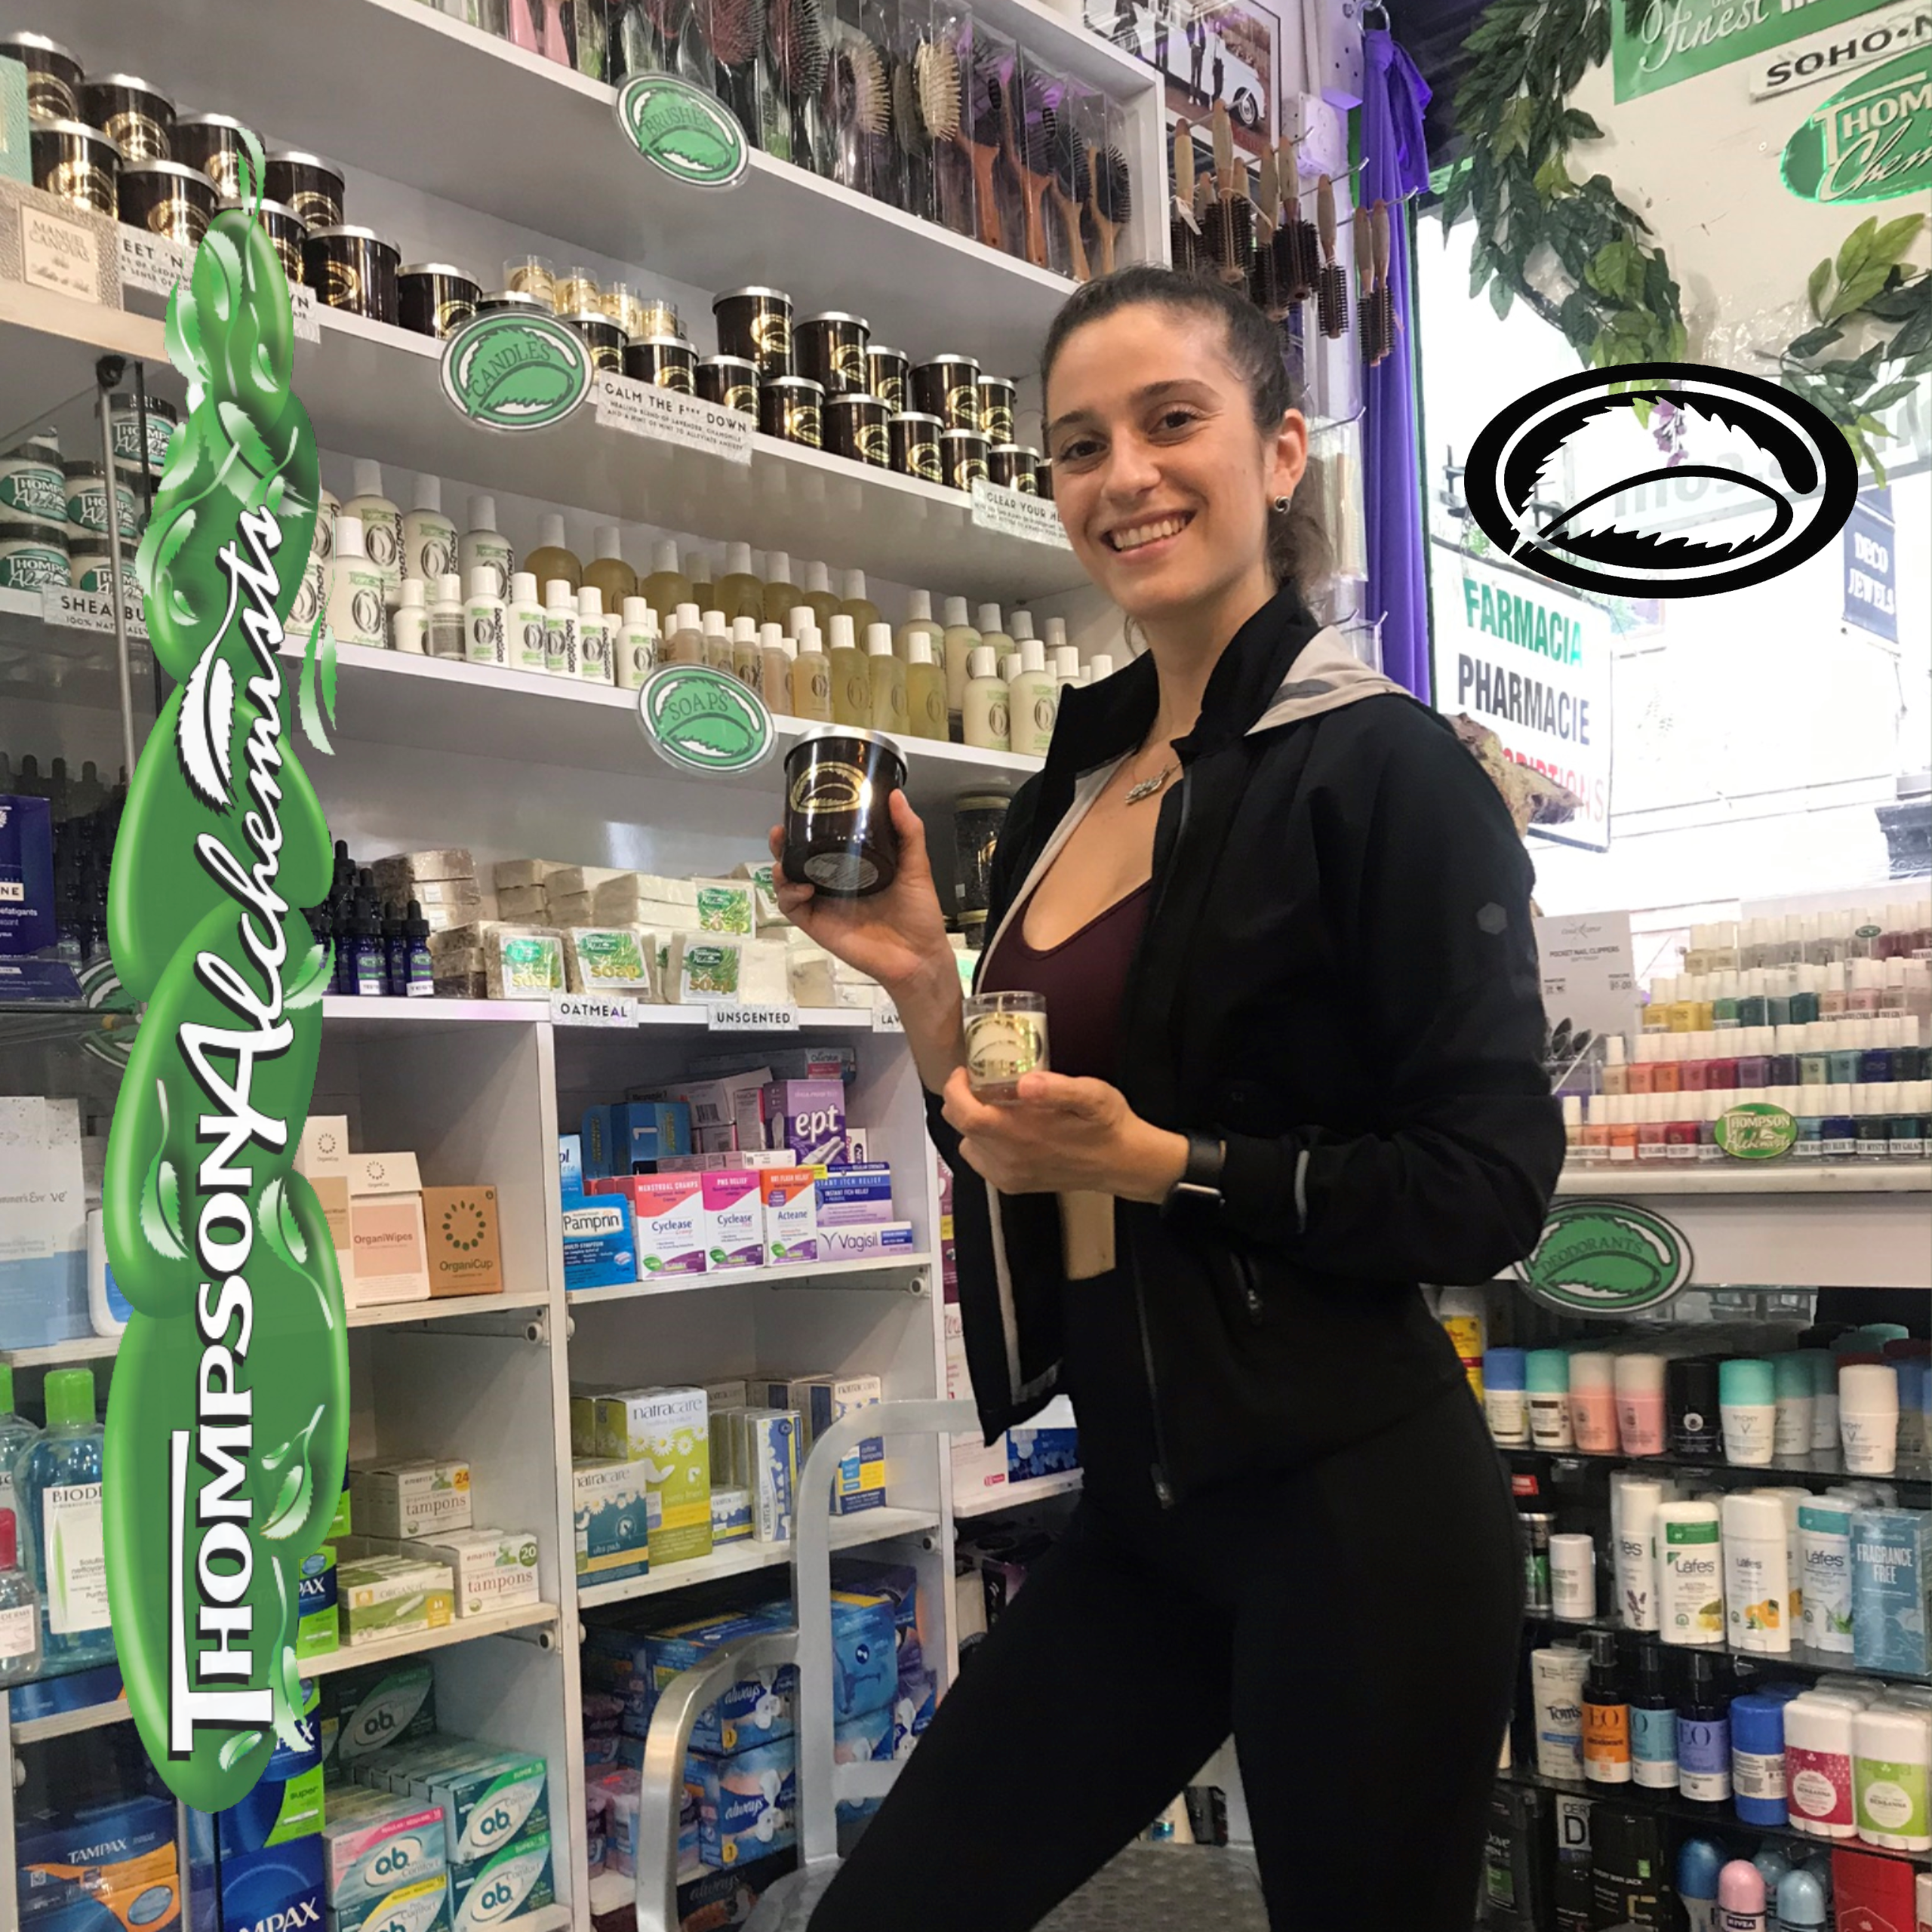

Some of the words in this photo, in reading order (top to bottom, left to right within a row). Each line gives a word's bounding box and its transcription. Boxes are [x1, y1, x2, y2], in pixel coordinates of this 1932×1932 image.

[645, 107, 712, 137] BRUSHES
[472, 341, 552, 398] CANDLES
[605, 383, 642, 403] CALM
[648, 395, 672, 412] THE
[706, 413, 747, 433] DOWN
[610, 401, 638, 414] HEALING
[640, 409, 660, 420] BLEND
[706, 427, 742, 442] CHAMOMILE
[659, 423, 674, 431] MINT
[687, 431, 717, 445] ALLEVIATE
[987, 492, 1016, 509] CLEAR
[1020, 502, 1045, 518] YOUR
[1852, 531, 1888, 574] DECO
[1847, 568, 1895, 616] JEWELS
[61, 595, 112, 615] SHEA
[66, 615, 92, 626] 100%
[1463, 577, 1583, 668] FARMACIA
[669, 692, 728, 721] SOAPS
[1458, 653, 1590, 746] PHARMACIE
[591, 965, 640, 981] soap
[689, 979, 733, 995] soap
[561, 1003, 628, 1018] OATMEAL
[717, 1012, 791, 1025] UNSCENTED
[1724, 1111, 1791, 1138] THOMPSON
[638, 1183, 674, 1192] MENSTRUAL
[675, 1180, 699, 1190] CRAMPS
[840, 1177, 856, 1186] ITCH
[859, 1177, 881, 1185] RELIEF
[564, 1214, 620, 1232] Pamprin
[717, 1214, 753, 1227] Cyclease
[777, 1211, 808, 1220] Acteane
[651, 1220, 692, 1234] Cyclease
[354, 1232, 413, 1245] OrganiWipes
[838, 1232, 878, 1252] Vagisil
[439, 1259, 494, 1272] OrganiCup
[1541, 1236, 1644, 1273] DEODORANTS
[633, 1398, 703, 1420] natracare
[456, 1472, 469, 1484] 24
[406, 1494, 466, 1516] tampons
[521, 1546, 537, 1560] 20
[1857, 1543, 1913, 1567] FRAGRANCE
[468, 1571, 534, 1593] tampons
[1873, 1564, 1897, 1585] FREE
[724, 1684, 761, 1706] always
[1589, 1706, 1620, 1728] EO
[1679, 1723, 1712, 1747] EO
[290, 1784, 319, 1801] super
[725, 1798, 764, 1820] always
[67, 1838, 127, 1864] TAMPAX
[1626, 1877, 1642, 1886] JACK
[1728, 1918, 1755, 1928] NIVEA
